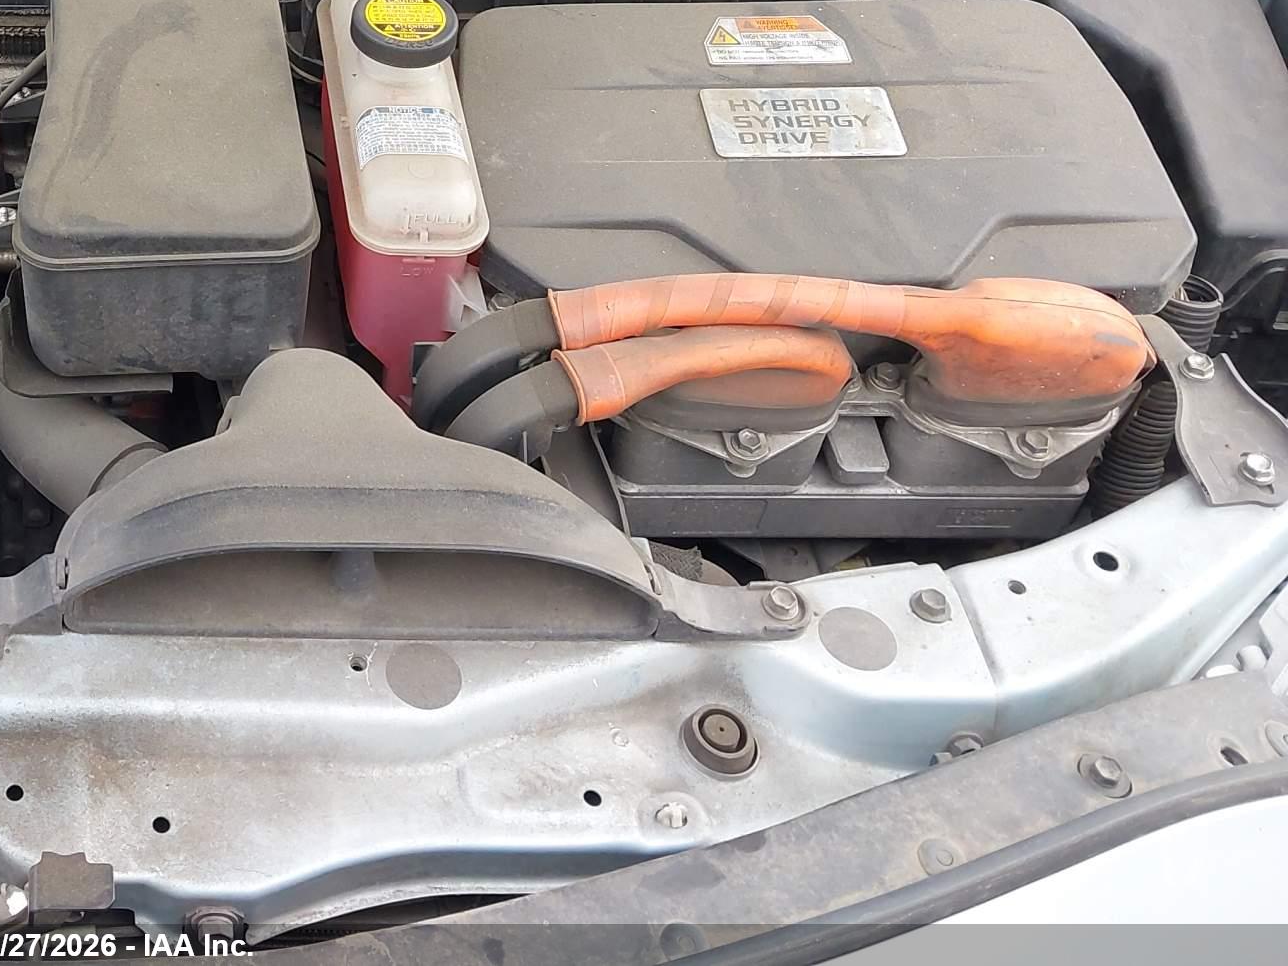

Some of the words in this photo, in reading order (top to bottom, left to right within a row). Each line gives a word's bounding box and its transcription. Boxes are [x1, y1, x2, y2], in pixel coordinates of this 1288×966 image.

[728, 98, 840, 112] HYBRID
[732, 114, 871, 128] SYNERGY
[739, 131, 830, 145] DRIVE
[414, 213, 456, 224] FULL
